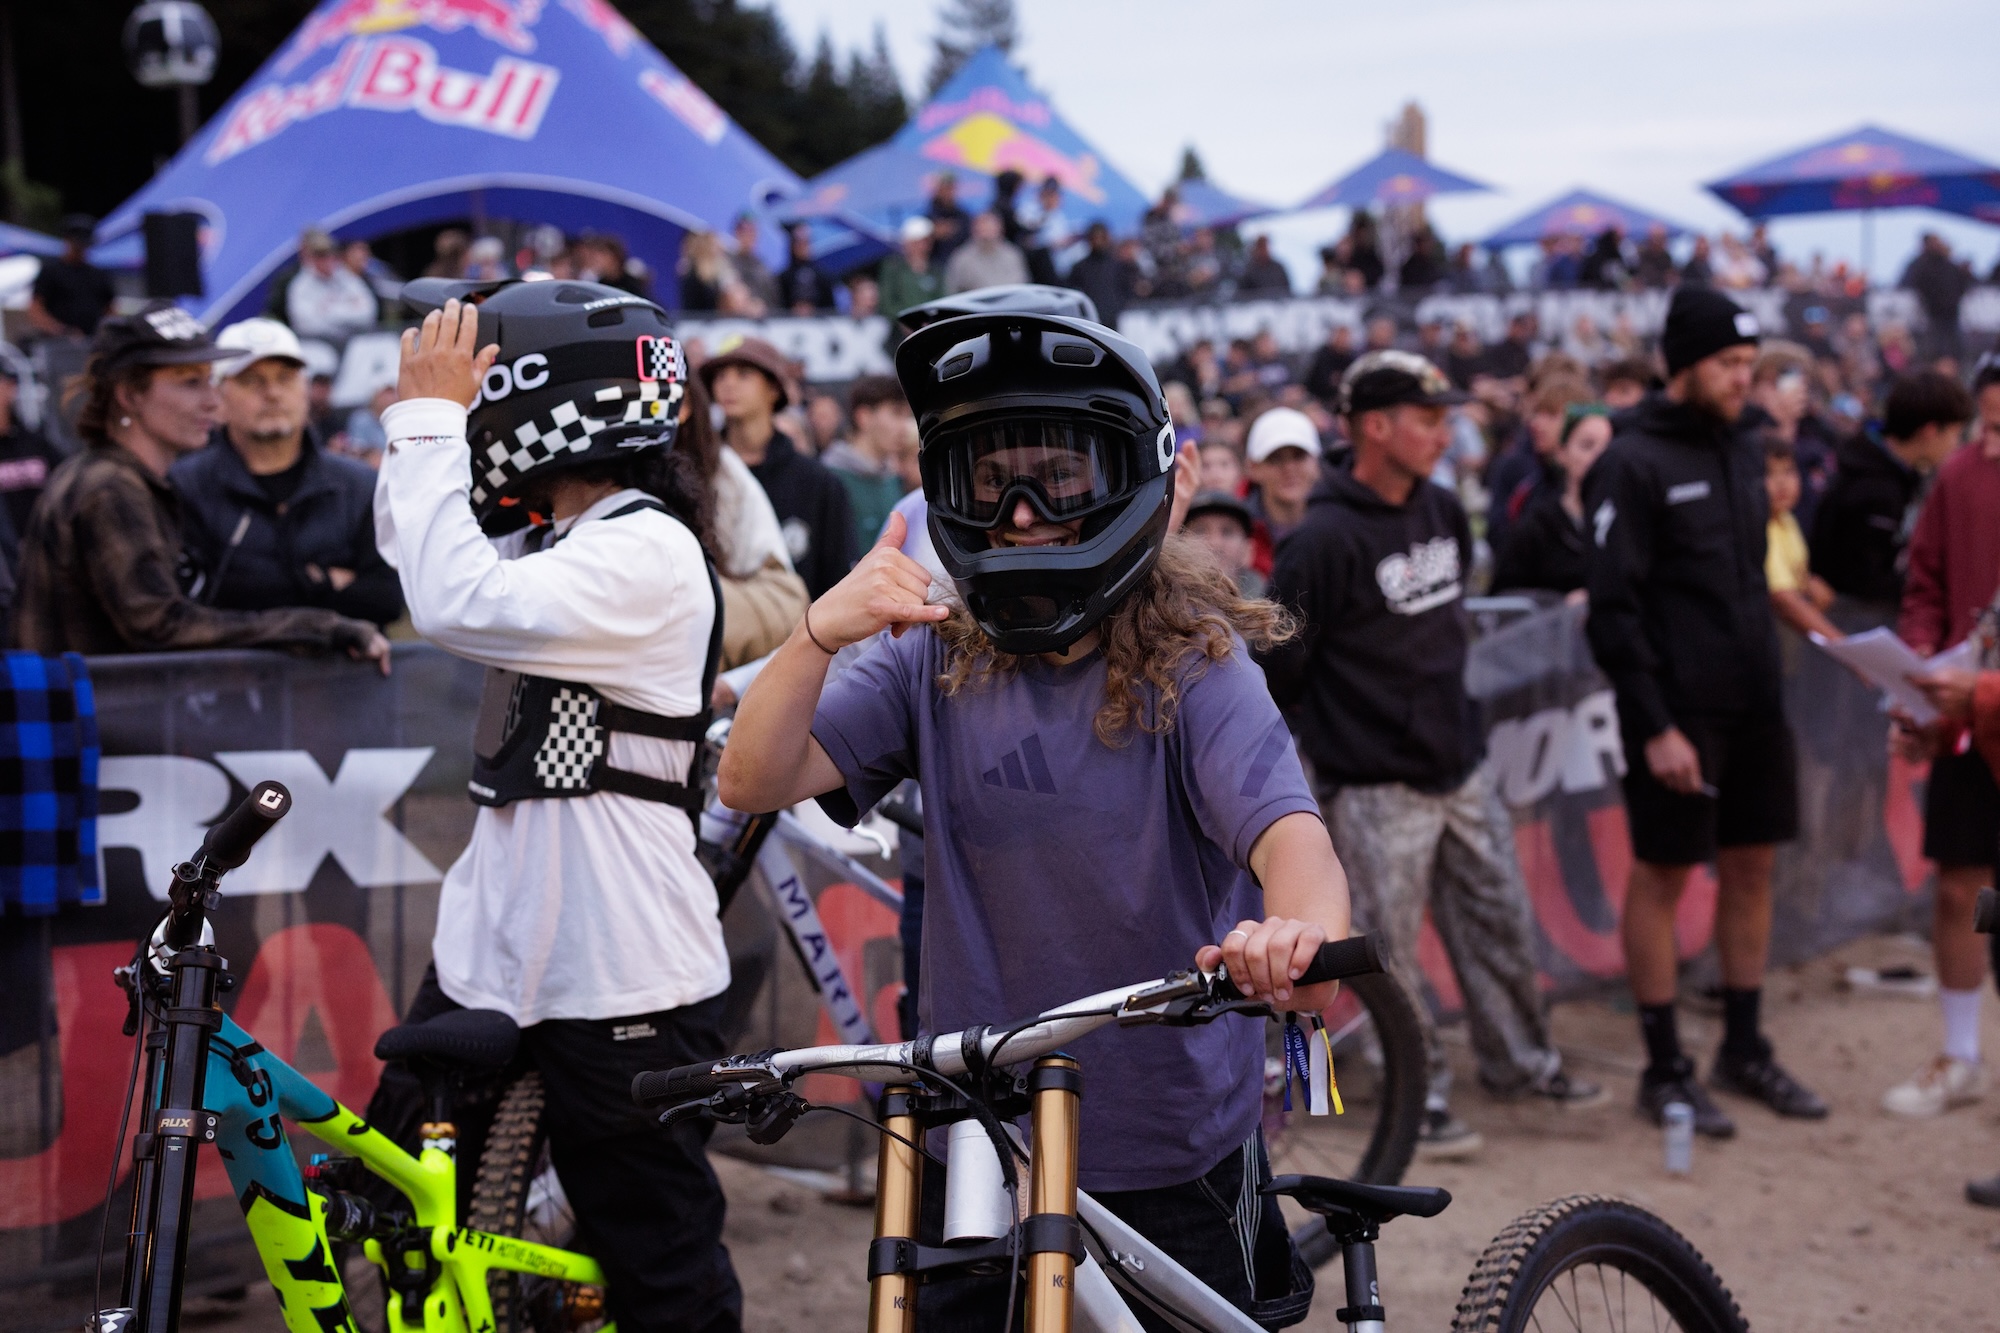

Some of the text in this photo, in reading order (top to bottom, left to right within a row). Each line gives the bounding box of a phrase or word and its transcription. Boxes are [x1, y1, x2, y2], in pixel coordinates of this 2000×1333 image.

[353, 37, 556, 138] Bull
[466, 352, 550, 416] OC
[1292, 1032, 1303, 1052] YOU
[160, 1118, 192, 1128] RUX
